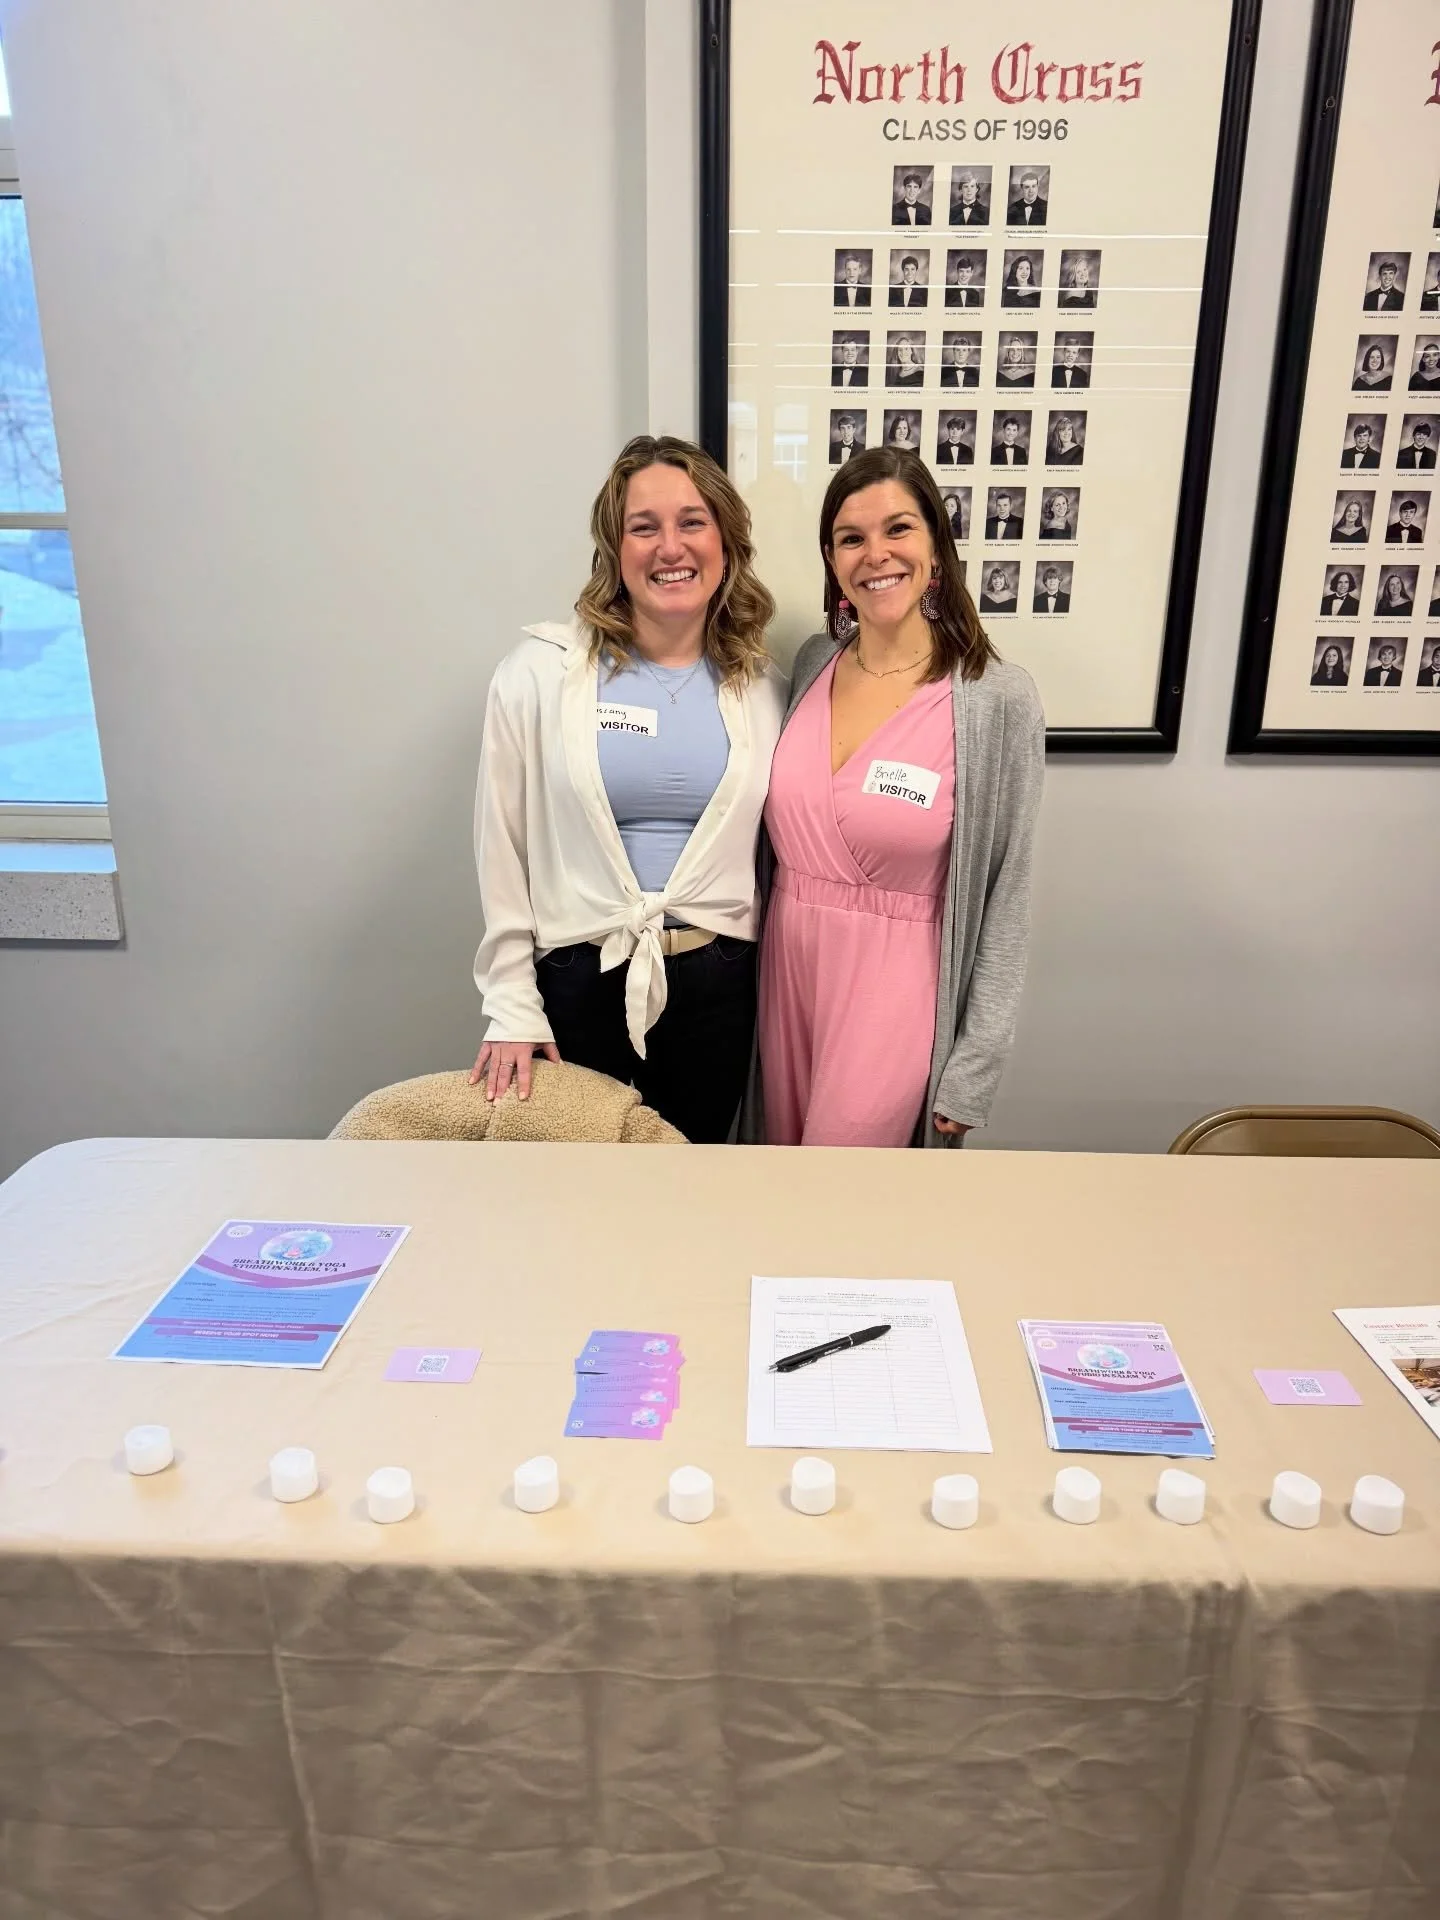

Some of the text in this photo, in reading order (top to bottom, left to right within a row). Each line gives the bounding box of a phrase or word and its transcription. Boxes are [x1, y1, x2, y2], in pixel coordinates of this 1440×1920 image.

[813, 40, 1146, 104] North Cross
[882, 118, 1069, 141] CLASS OF 1996
[600, 721, 649, 734] VISITOR
[874, 765, 908, 782] Brielle
[879, 783, 927, 805] VISITOR
